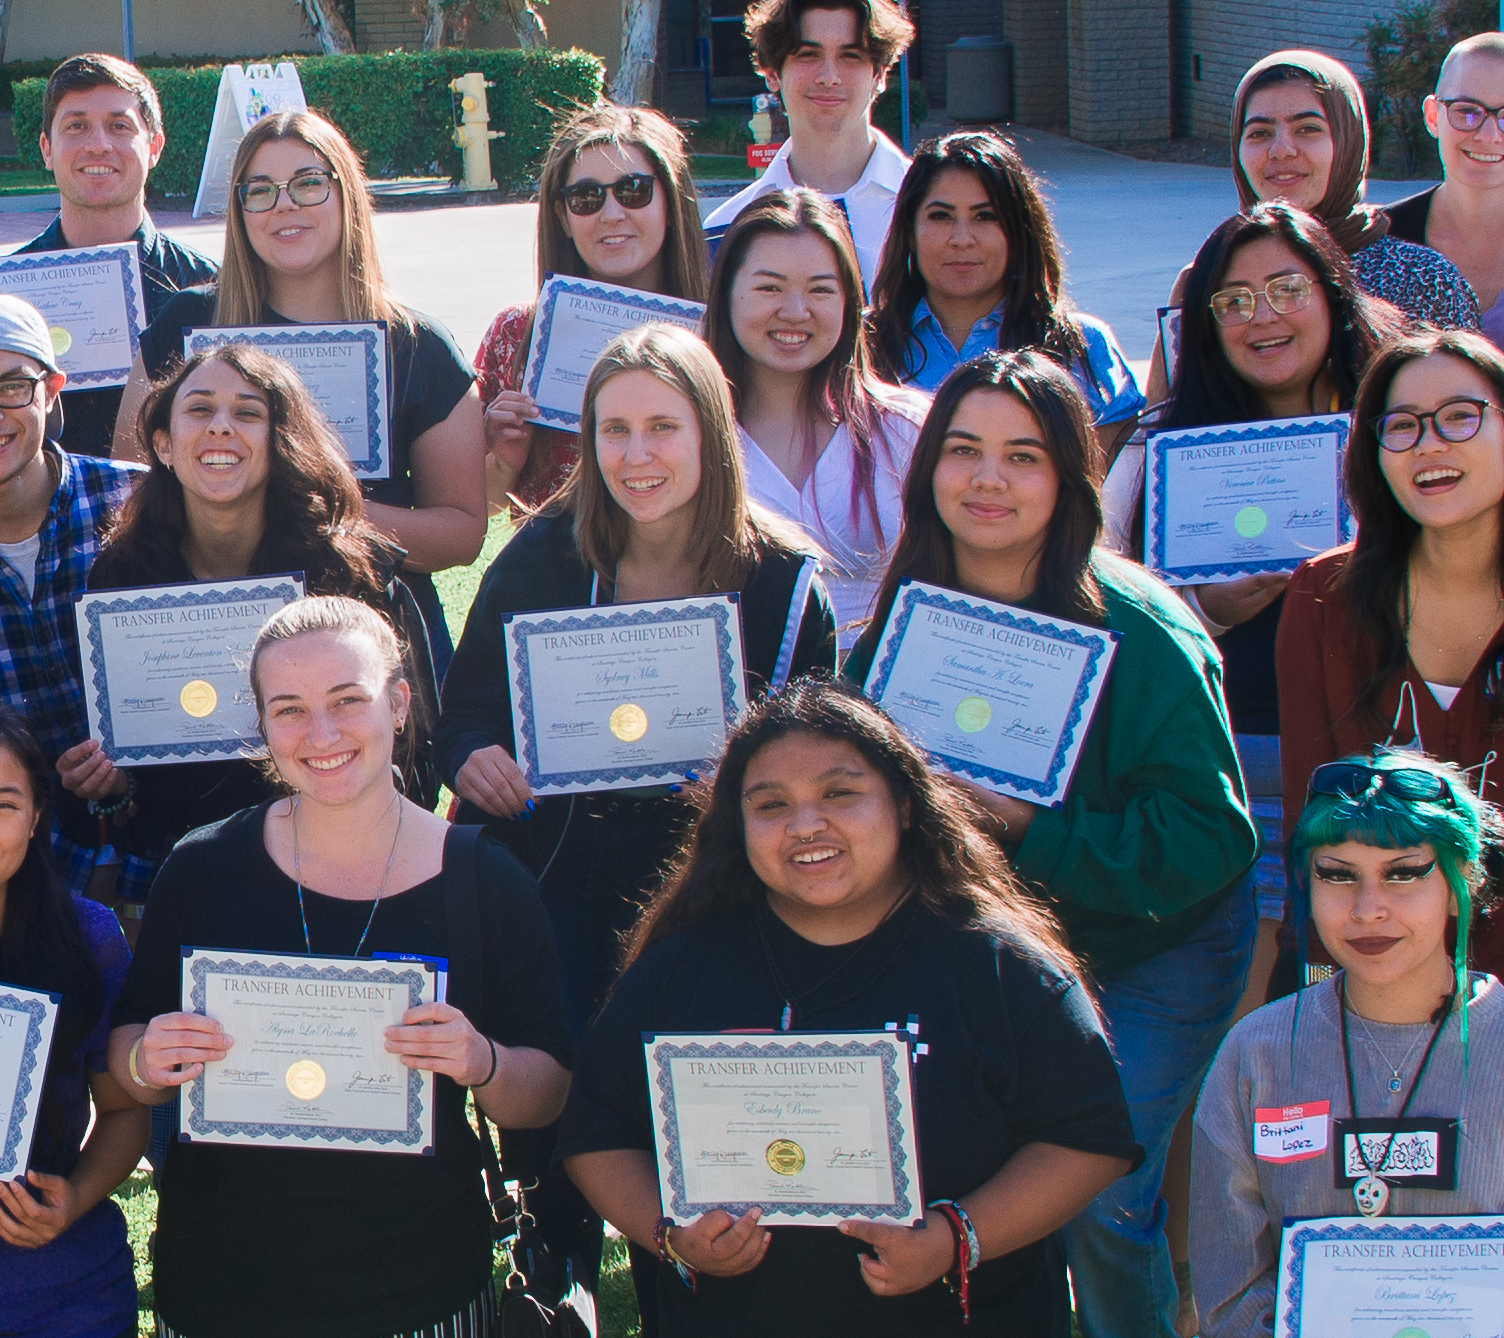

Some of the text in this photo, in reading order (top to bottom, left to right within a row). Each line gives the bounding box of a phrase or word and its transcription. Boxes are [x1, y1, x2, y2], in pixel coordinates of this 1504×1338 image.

[42, 264, 111, 281] ACHIEVEMENT
[569, 296, 620, 317] TRANSFER
[276, 345, 353, 359] ACHIEVEMENT
[1178, 437, 1323, 461] TRANSFER ACHIEVEMENT
[112, 603, 269, 628] TRANSFER ACHIEVEMENT
[541, 623, 701, 649] TRANSFER ACHIEVEMENT
[926, 610, 984, 636] TRANSFER
[987, 627, 1076, 660] ACHIEVEMENT
[138, 649, 180, 666] Josephine
[943, 654, 986, 676] Samantha
[596, 670, 630, 686] Sydney
[222, 978, 395, 1000] TRANSFER ACHIEVEMENT
[687, 1061, 866, 1075] TRANSFER ACHIEVEMENT
[786, 1101, 823, 1115] Bruno
[1282, 1106, 1304, 1116] Hello
[1260, 1121, 1304, 1138] Brittani
[1322, 1244, 1396, 1258] TRANSFER
[1374, 1285, 1457, 1305] Brittani Lopez
